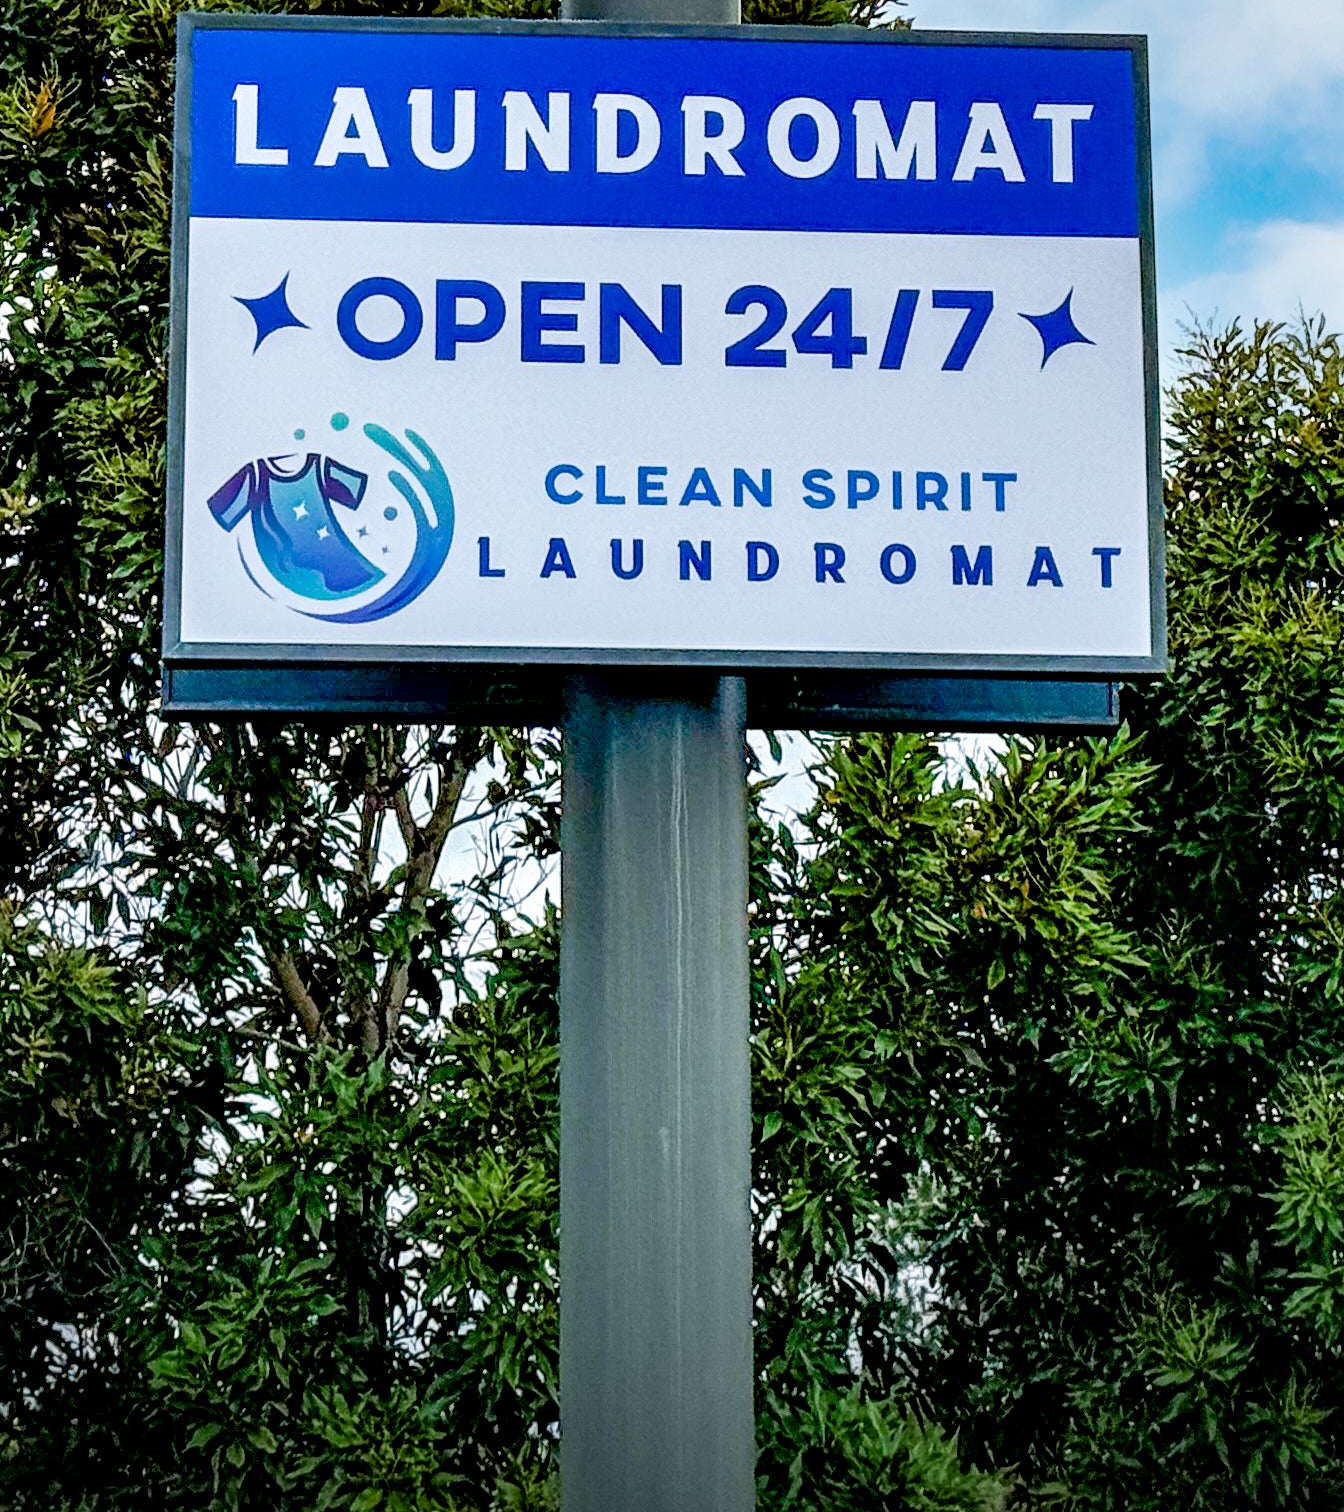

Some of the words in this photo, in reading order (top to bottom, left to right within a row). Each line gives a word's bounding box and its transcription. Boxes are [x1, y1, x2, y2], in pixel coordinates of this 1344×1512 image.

[231, 84, 1094, 185] LAUNDROMAT
[336, 276, 683, 367] OPEN
[723, 285, 994, 372] 24/7
[544, 464, 773, 508] CLEAN
[802, 469, 1018, 513] SPIRIT
[479, 535, 1123, 589] LAUNDROMAT
